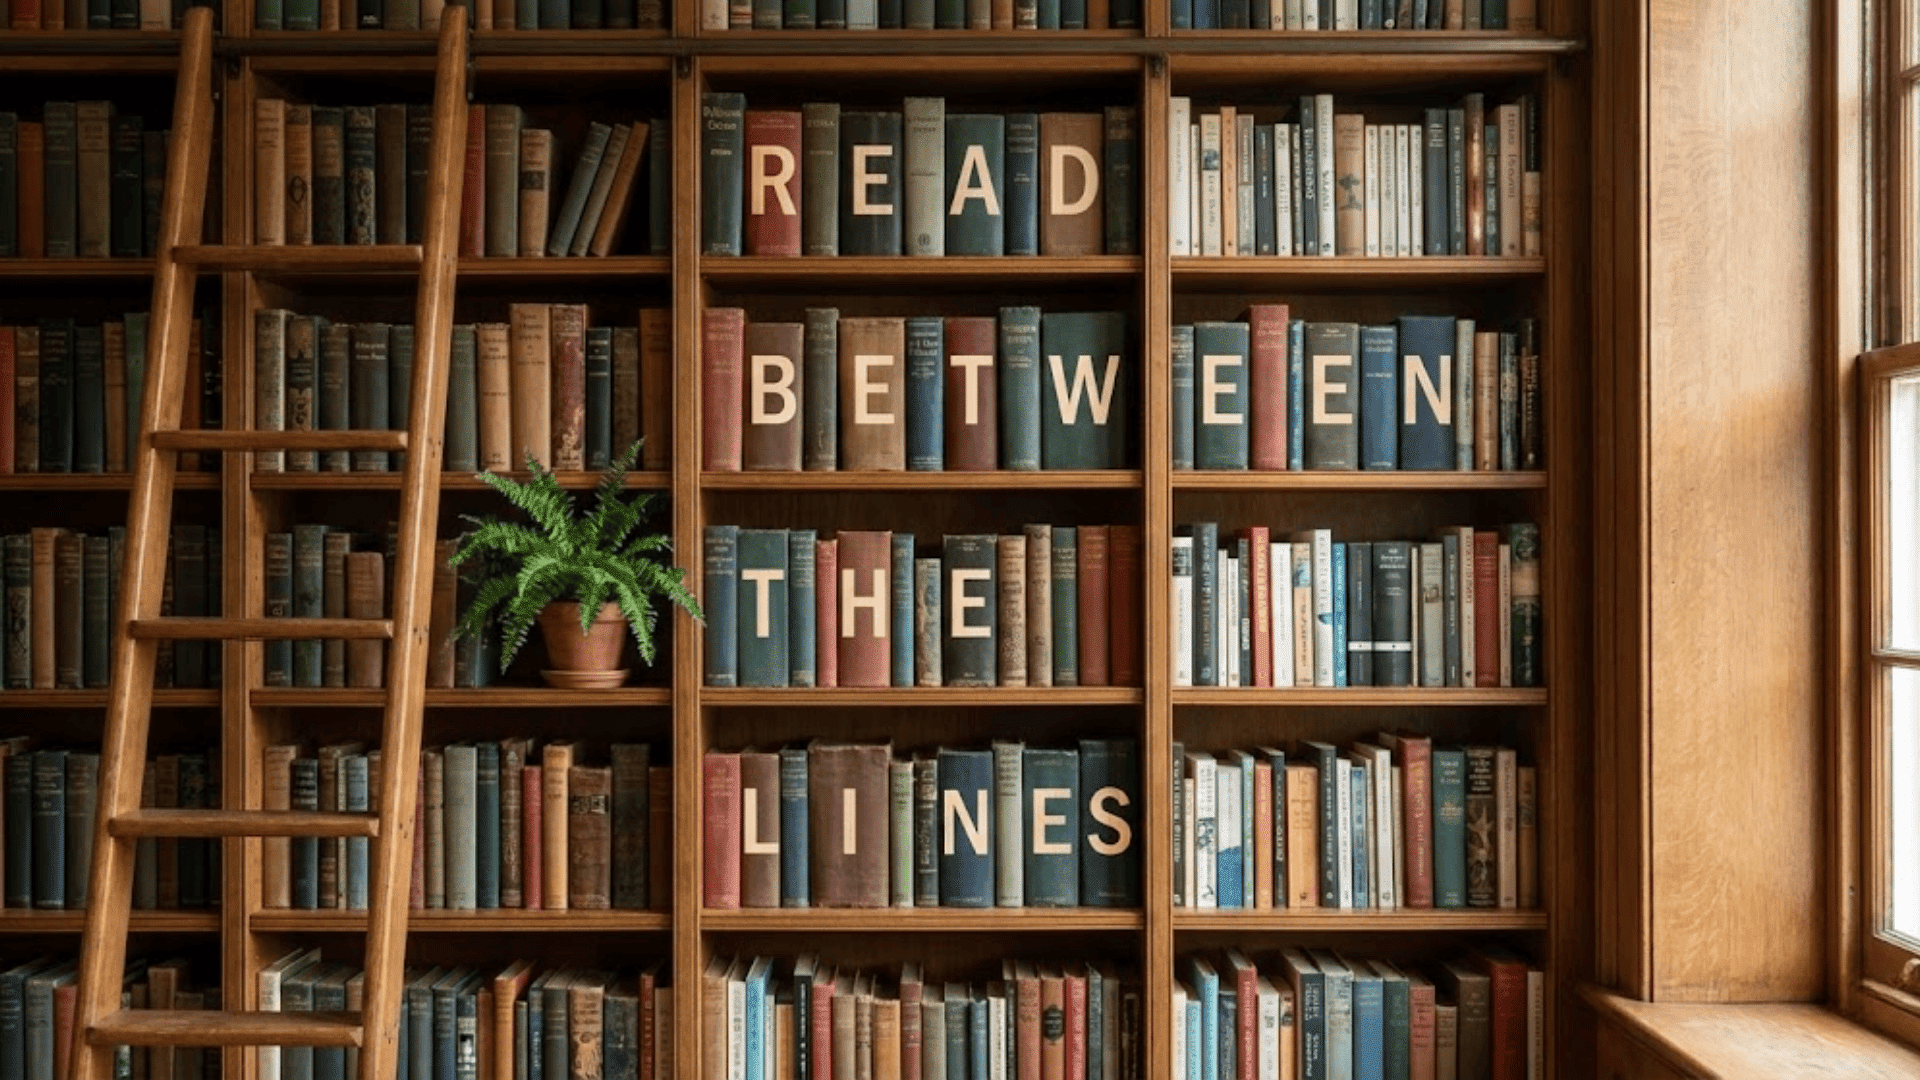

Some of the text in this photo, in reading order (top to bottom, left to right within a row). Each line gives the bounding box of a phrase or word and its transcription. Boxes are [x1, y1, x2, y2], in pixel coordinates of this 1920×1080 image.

[750, 145, 1099, 216] READ
[751, 355, 1452, 425] BETWEEN
[741, 568, 992, 638] THE
[743, 786, 1132, 856] LINES
